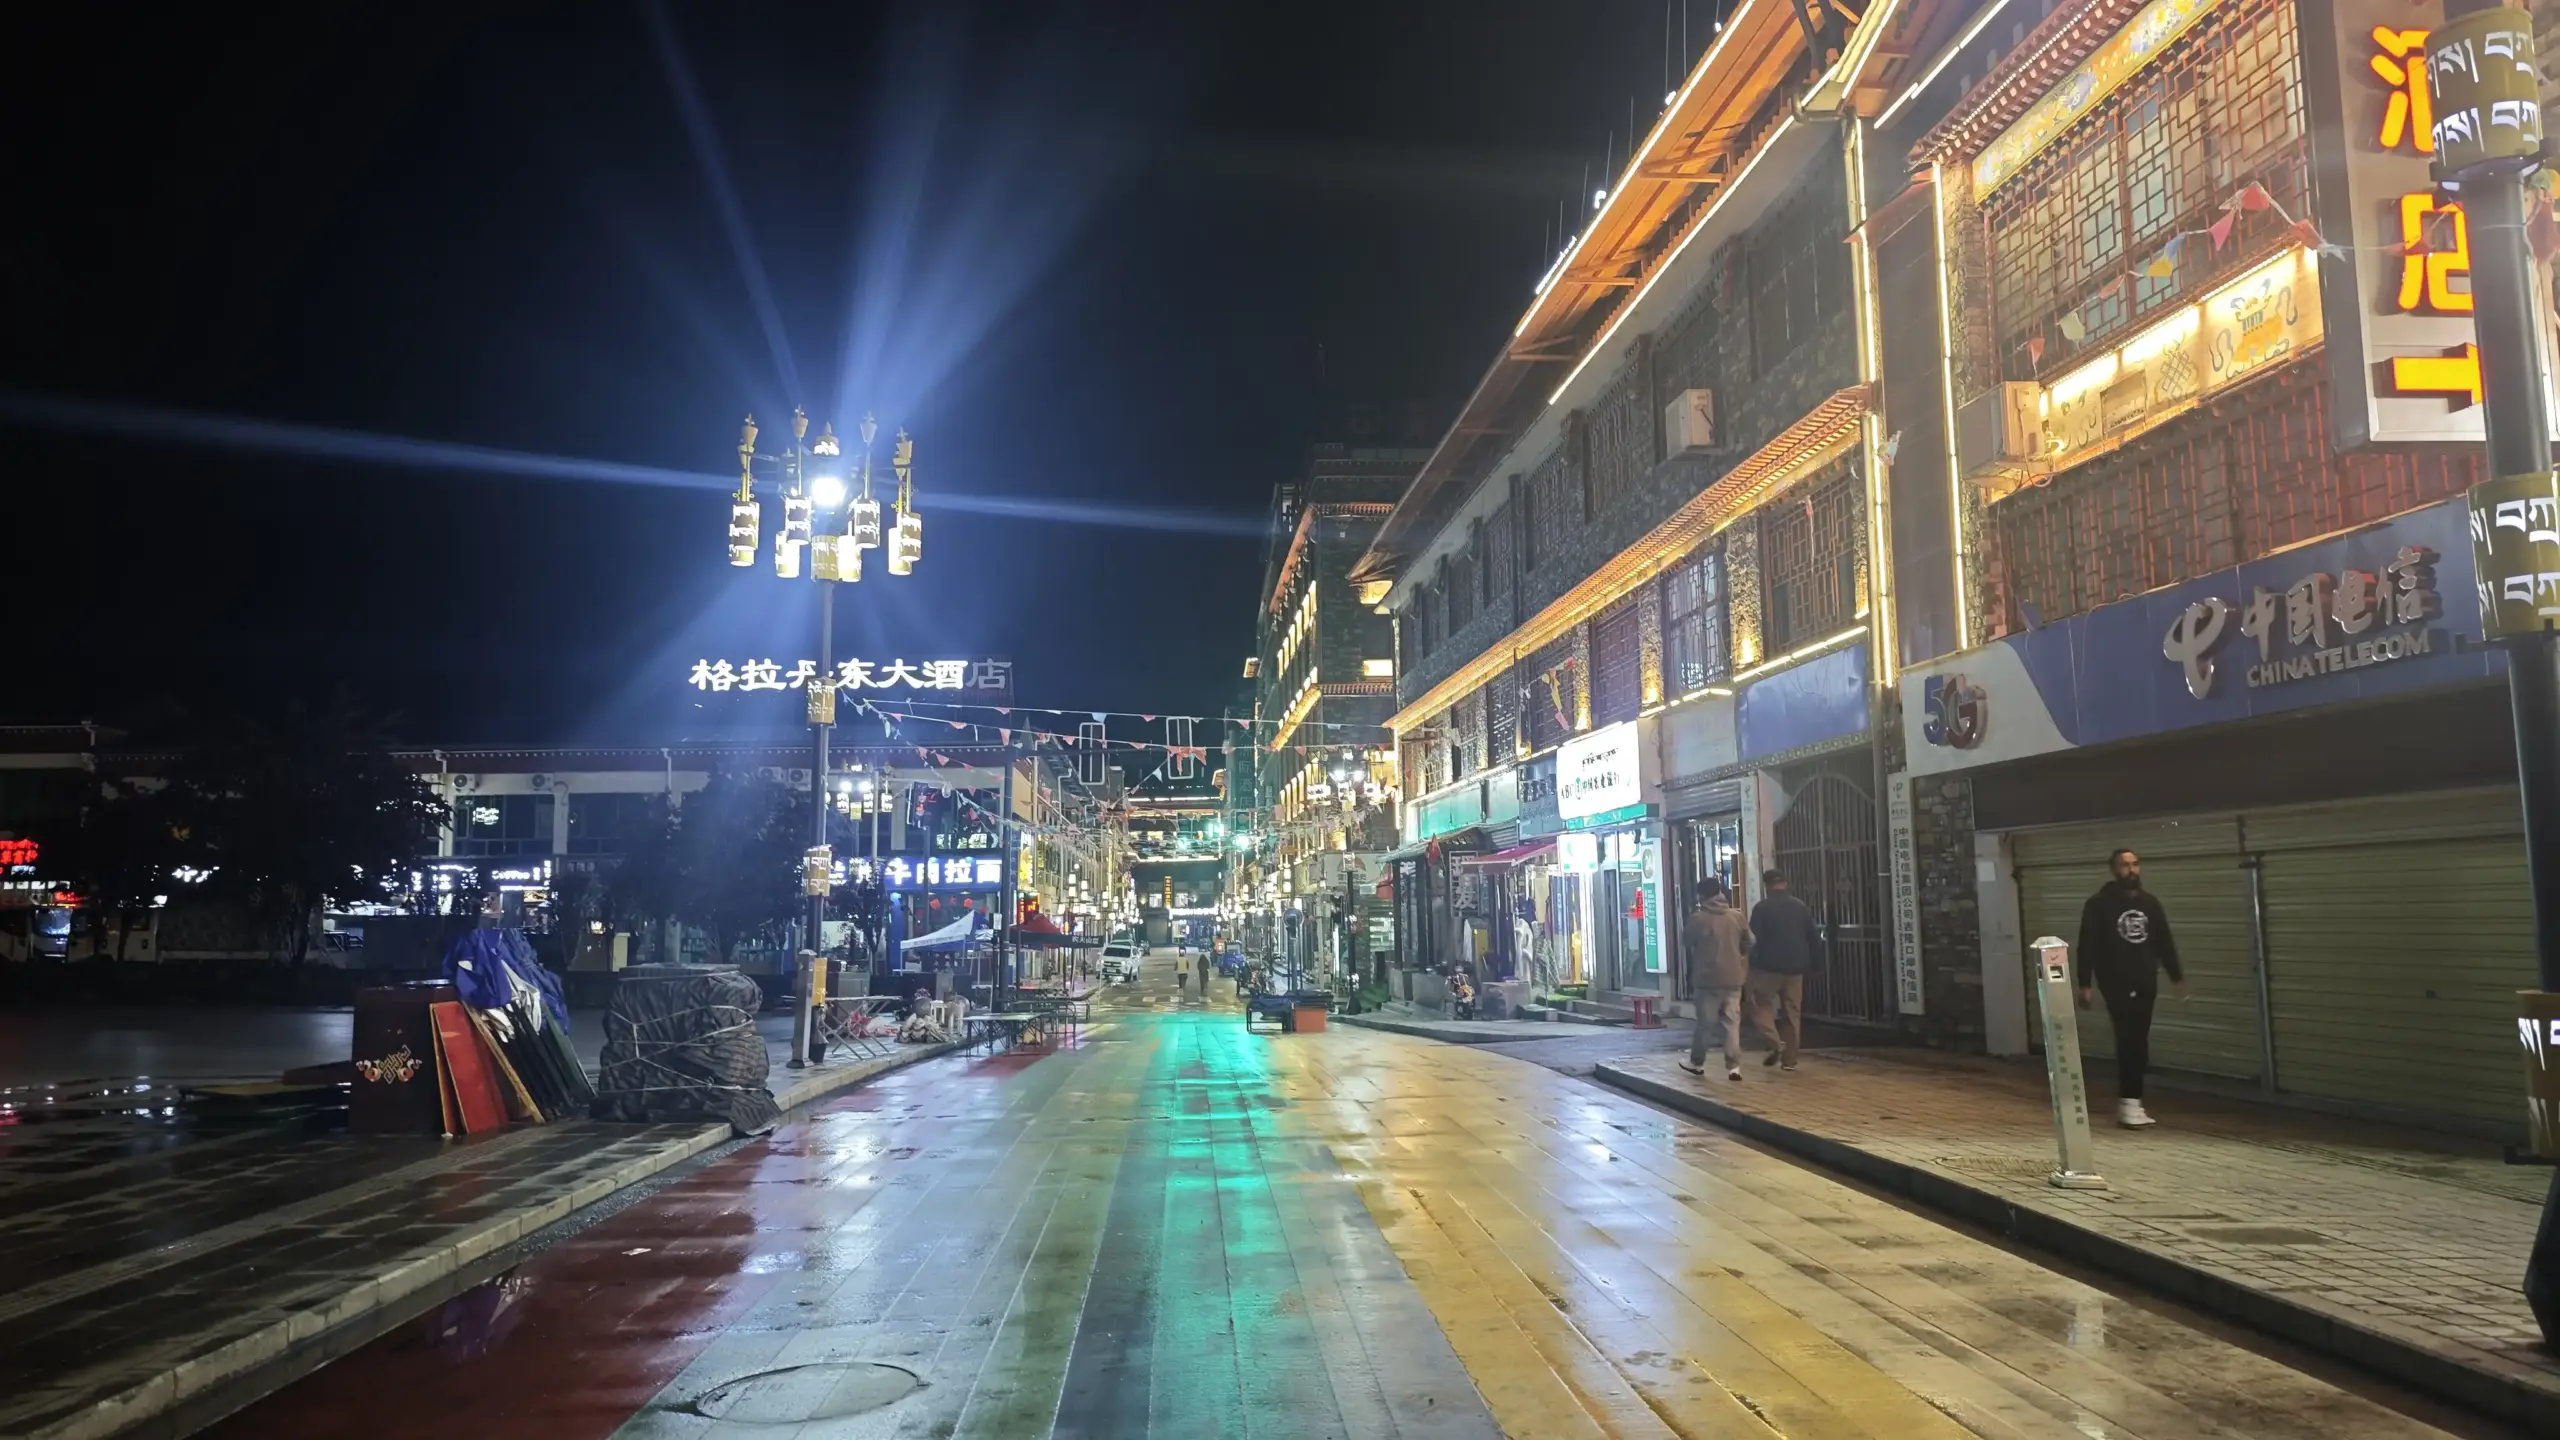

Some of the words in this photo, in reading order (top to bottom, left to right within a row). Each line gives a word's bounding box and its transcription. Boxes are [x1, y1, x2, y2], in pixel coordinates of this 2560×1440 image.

[2241, 546, 2424, 661] 中国电信
[689, 658, 1012, 691] 格拉丹东大酒店
[1923, 673, 1988, 750] 5G
